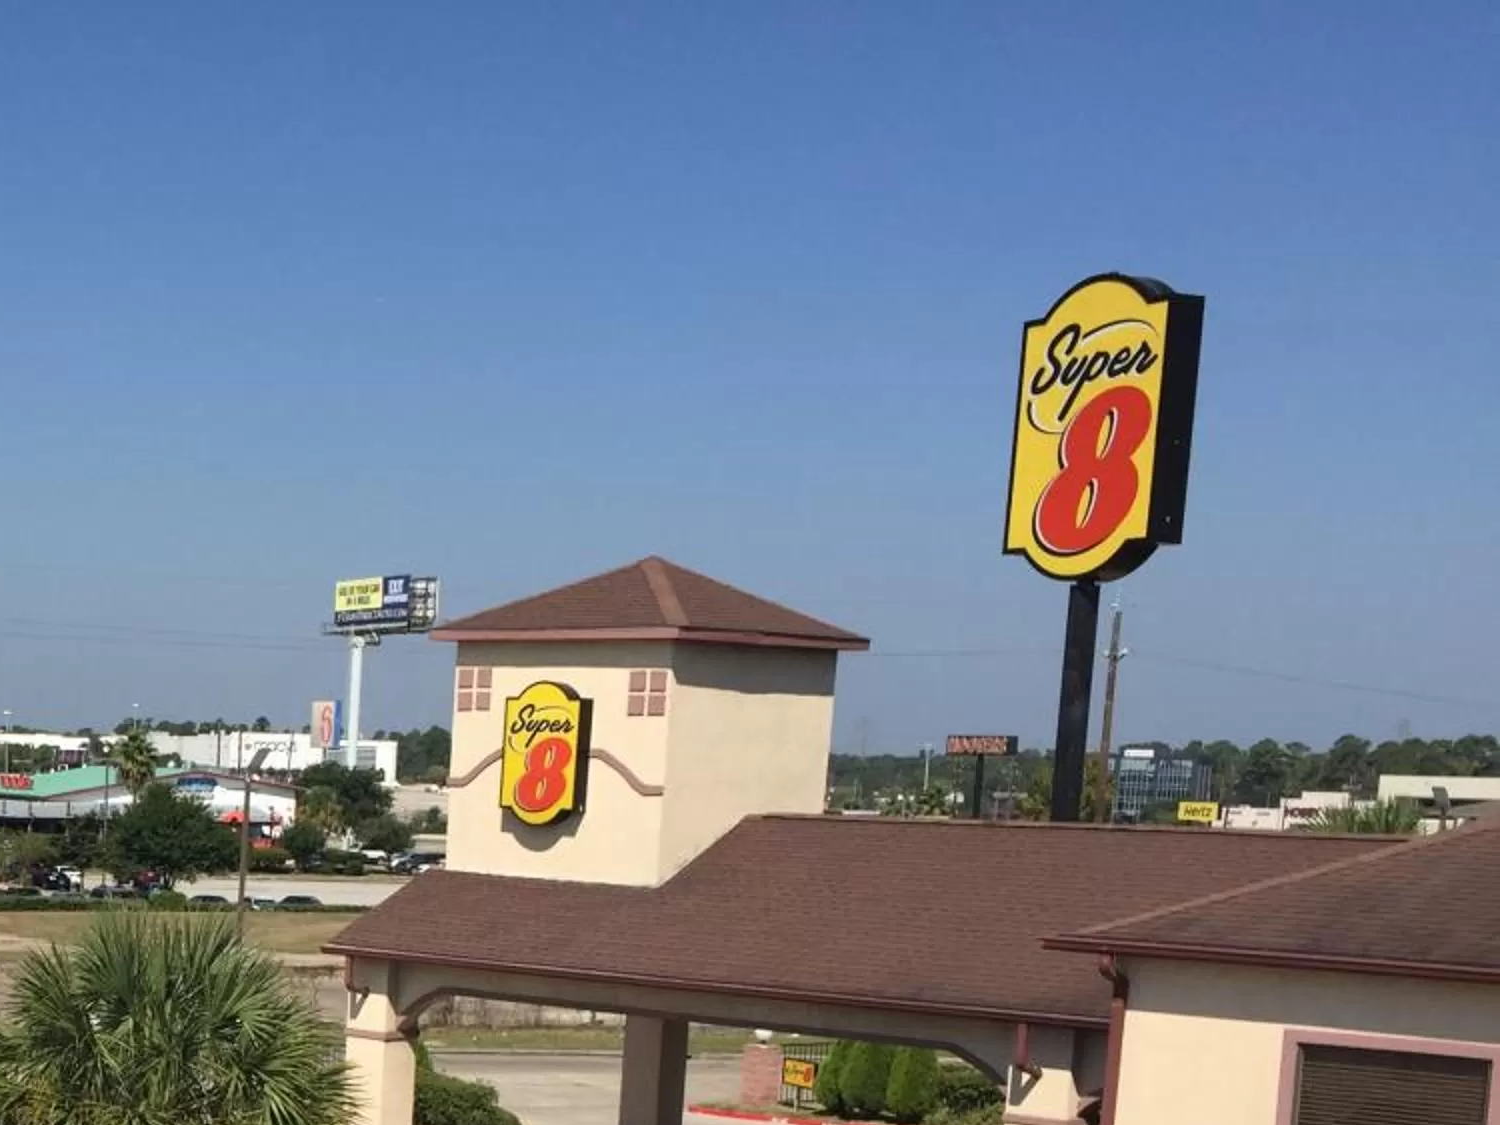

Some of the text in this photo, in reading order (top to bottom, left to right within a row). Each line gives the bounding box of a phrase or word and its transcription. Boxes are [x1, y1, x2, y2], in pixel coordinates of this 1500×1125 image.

[1030, 322, 1158, 422] Super
[1032, 385, 1153, 557] 8
[510, 704, 574, 748] Super
[514, 737, 573, 812] 8
[1183, 804, 1213, 818] Hertz
